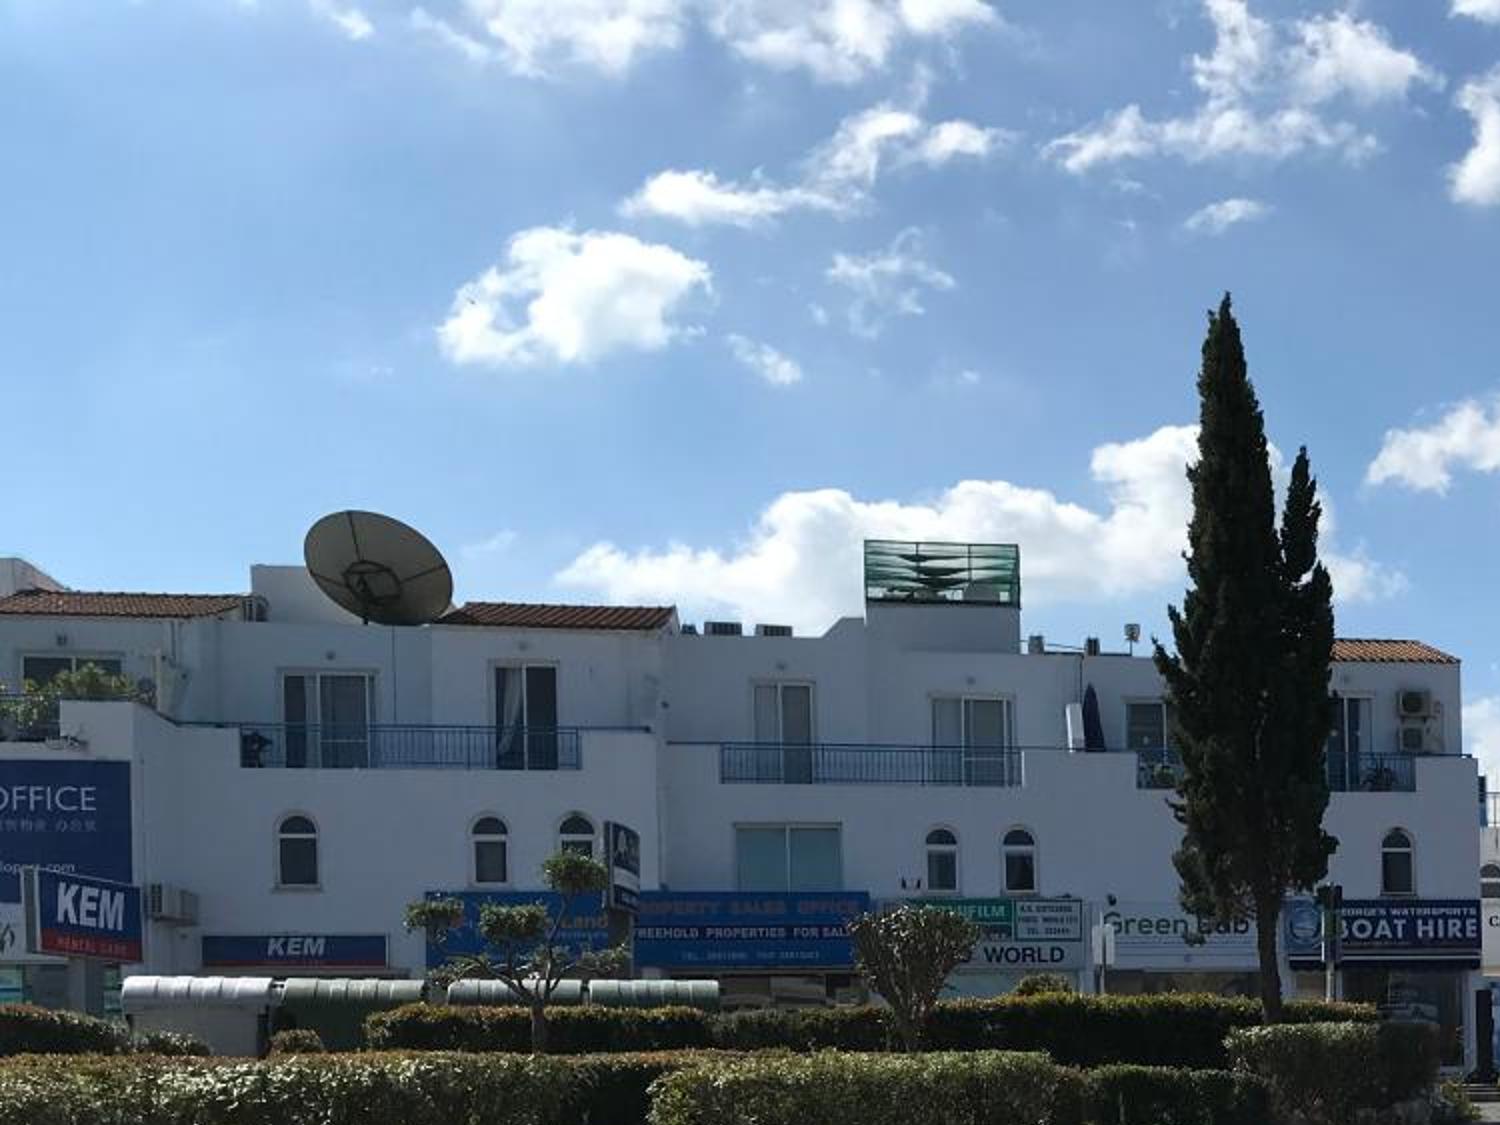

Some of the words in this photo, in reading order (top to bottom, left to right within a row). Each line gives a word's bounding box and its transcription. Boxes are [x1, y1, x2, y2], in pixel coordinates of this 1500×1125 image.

[57, 881, 125, 931] KEM
[1104, 911, 1188, 935] Green
[1416, 918, 1477, 939] HIRE
[706, 927, 786, 940] PROPERTIES
[793, 927, 818, 940] FOR
[266, 937, 326, 957] KEM
[983, 946, 1065, 963] WORLD
